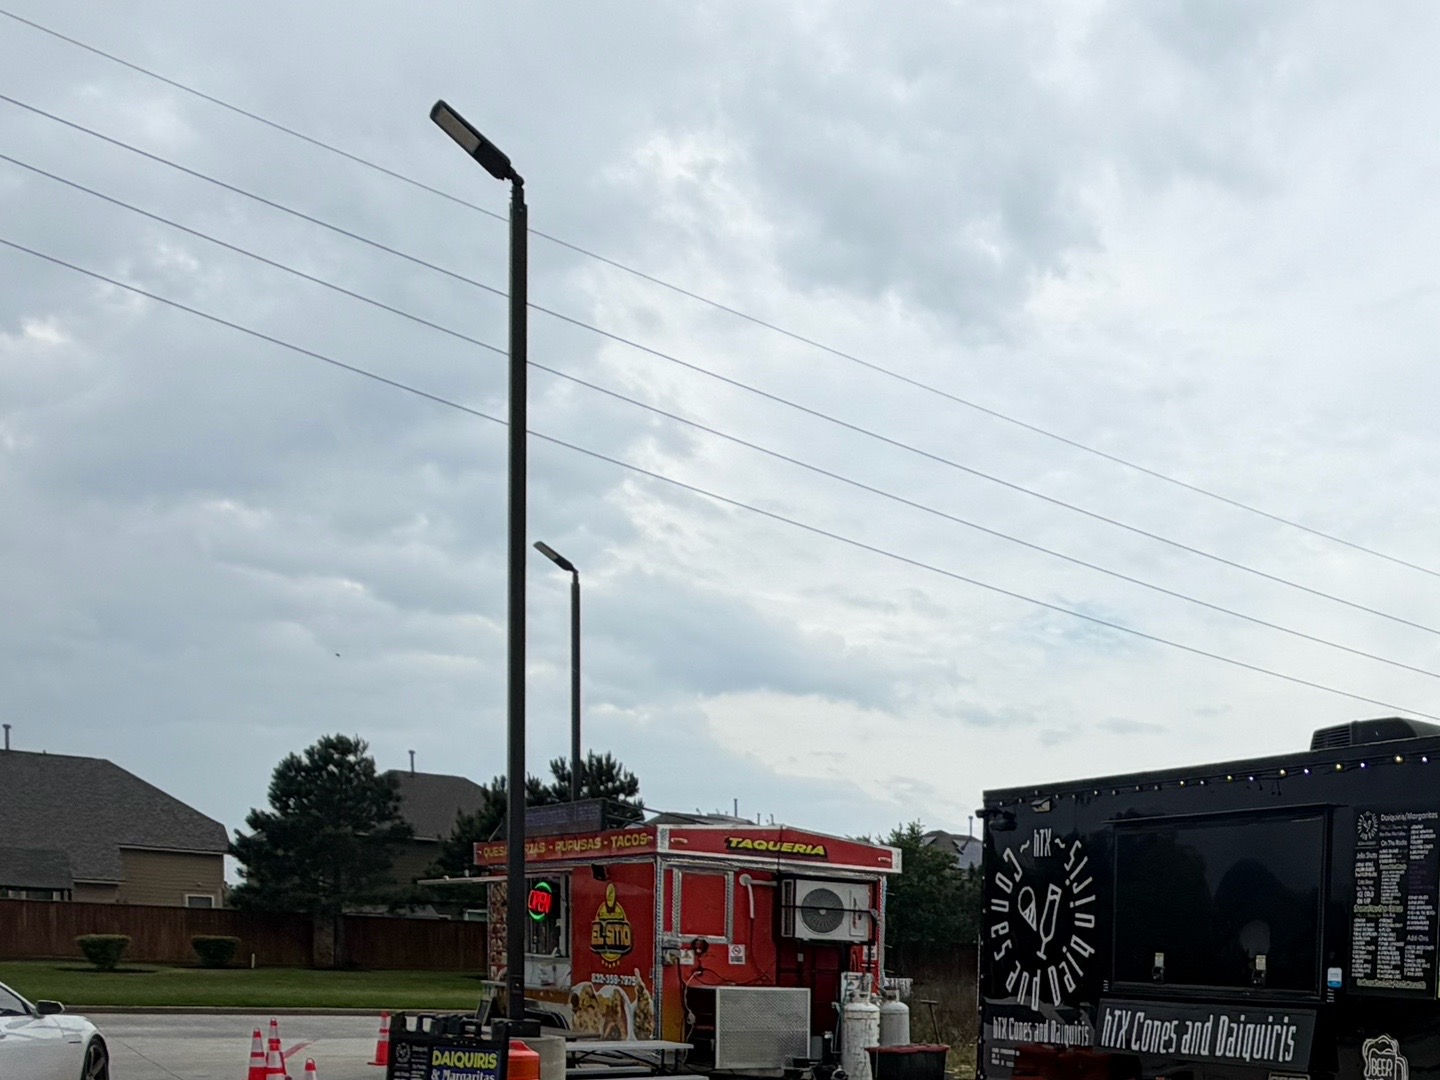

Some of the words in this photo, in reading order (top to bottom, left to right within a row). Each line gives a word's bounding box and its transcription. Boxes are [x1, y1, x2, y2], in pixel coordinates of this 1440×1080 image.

[555, 837, 602, 853] PUPUSAS
[611, 833, 648, 848] TACOS
[728, 837, 826, 856] TAQUERIA
[1033, 828, 1052, 858] hTX
[528, 890, 552, 914] OPEN
[1009, 1017, 1032, 1042] Cones
[1034, 1019, 1049, 1044] and
[1050, 1020, 1089, 1049] Daiquiris
[1101, 1008, 1132, 1050] hTX
[1130, 1012, 1179, 1054] Cones
[1180, 1014, 1213, 1056] and
[1215, 1014, 1297, 1063] Daiquiris
[431, 1050, 497, 1070] DAIQUIRIS
[1371, 1057, 1393, 1078] BEER
